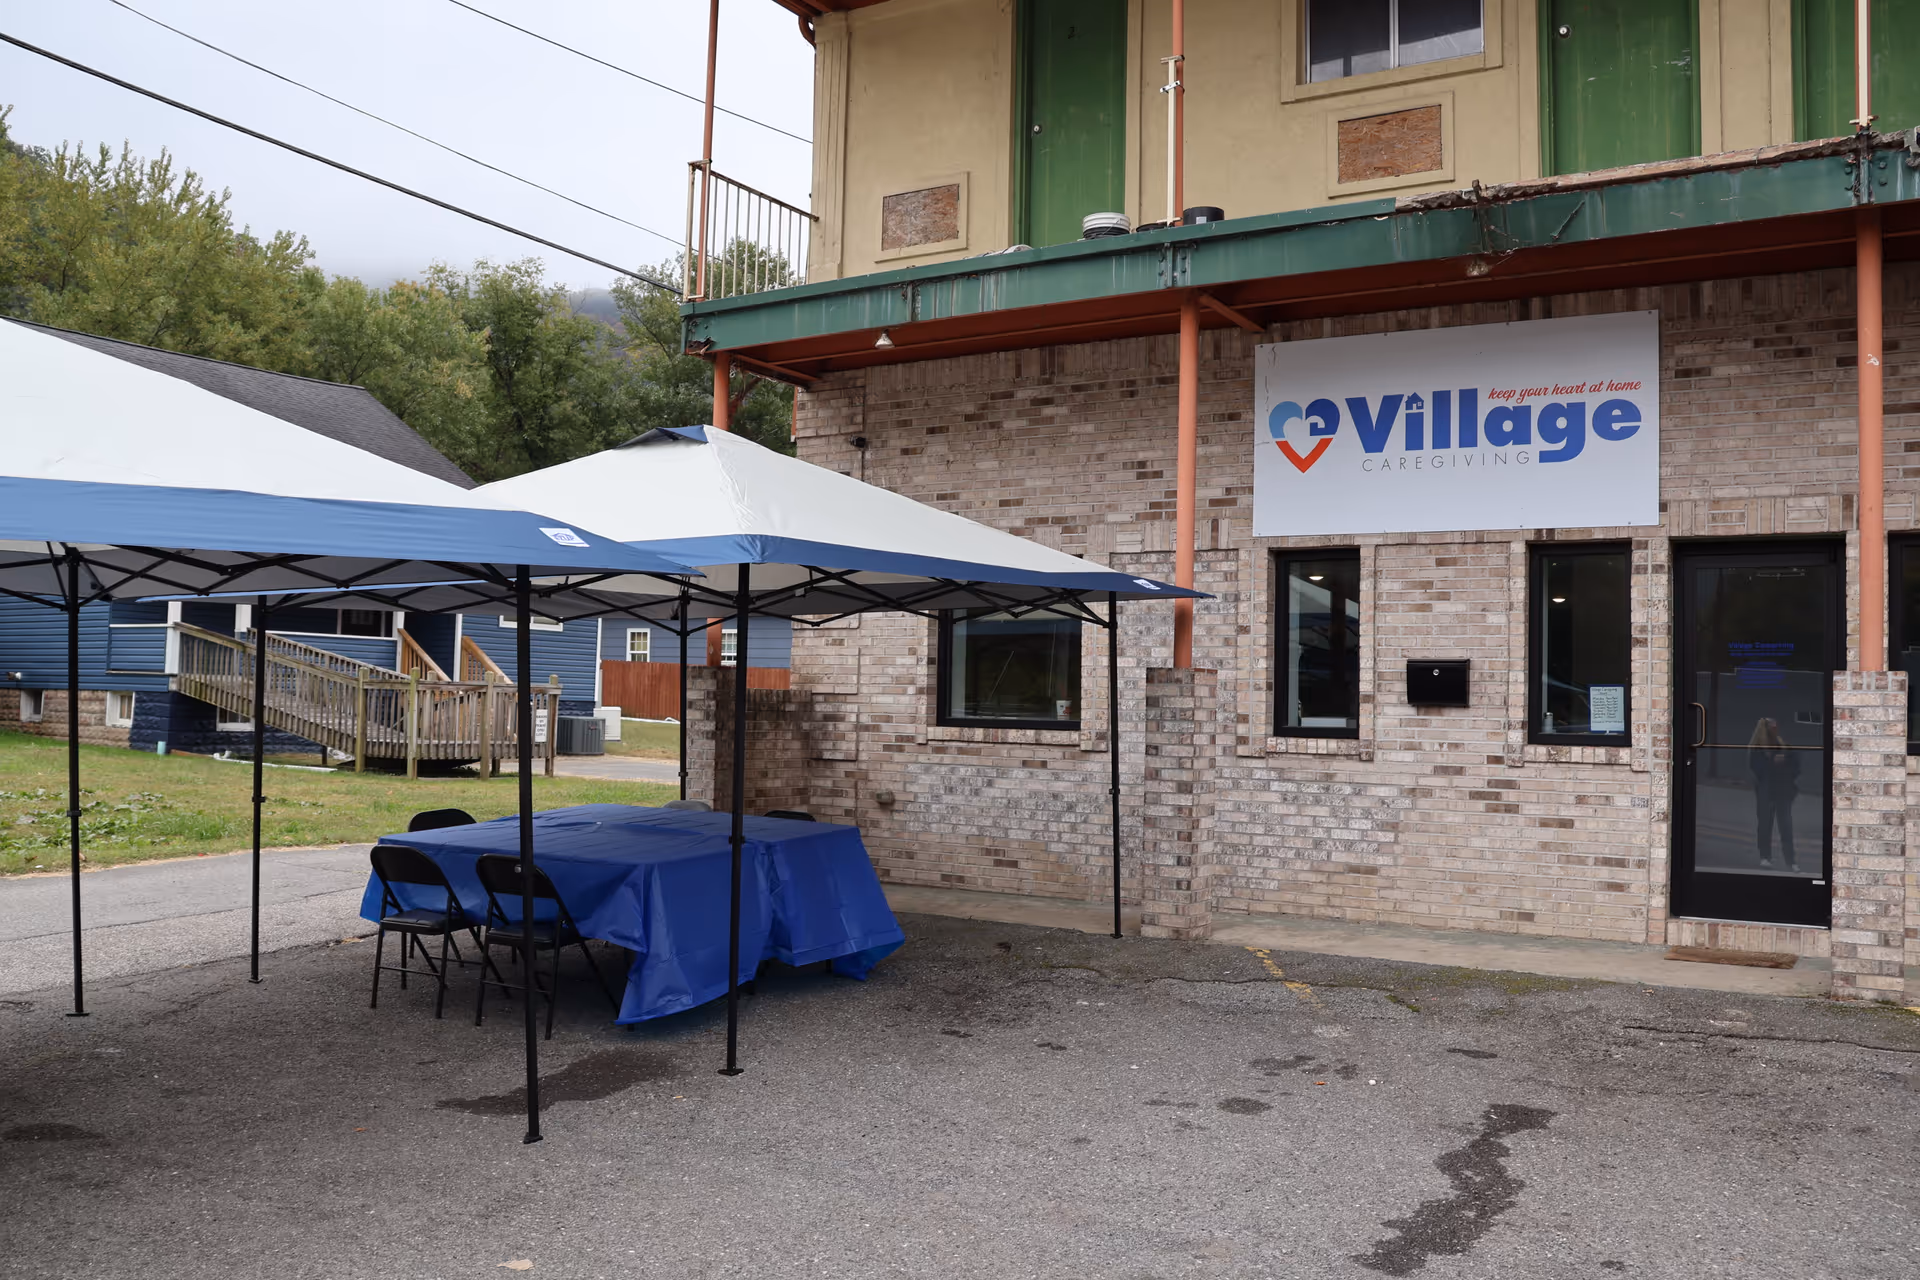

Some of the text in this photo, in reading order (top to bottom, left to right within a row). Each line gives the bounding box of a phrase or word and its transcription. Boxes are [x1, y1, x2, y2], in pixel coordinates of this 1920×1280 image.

[1488, 379, 1642, 404] keep your heart at home
[1345, 388, 1642, 463] Village
[1362, 451, 1530, 472] CAREGIVING
